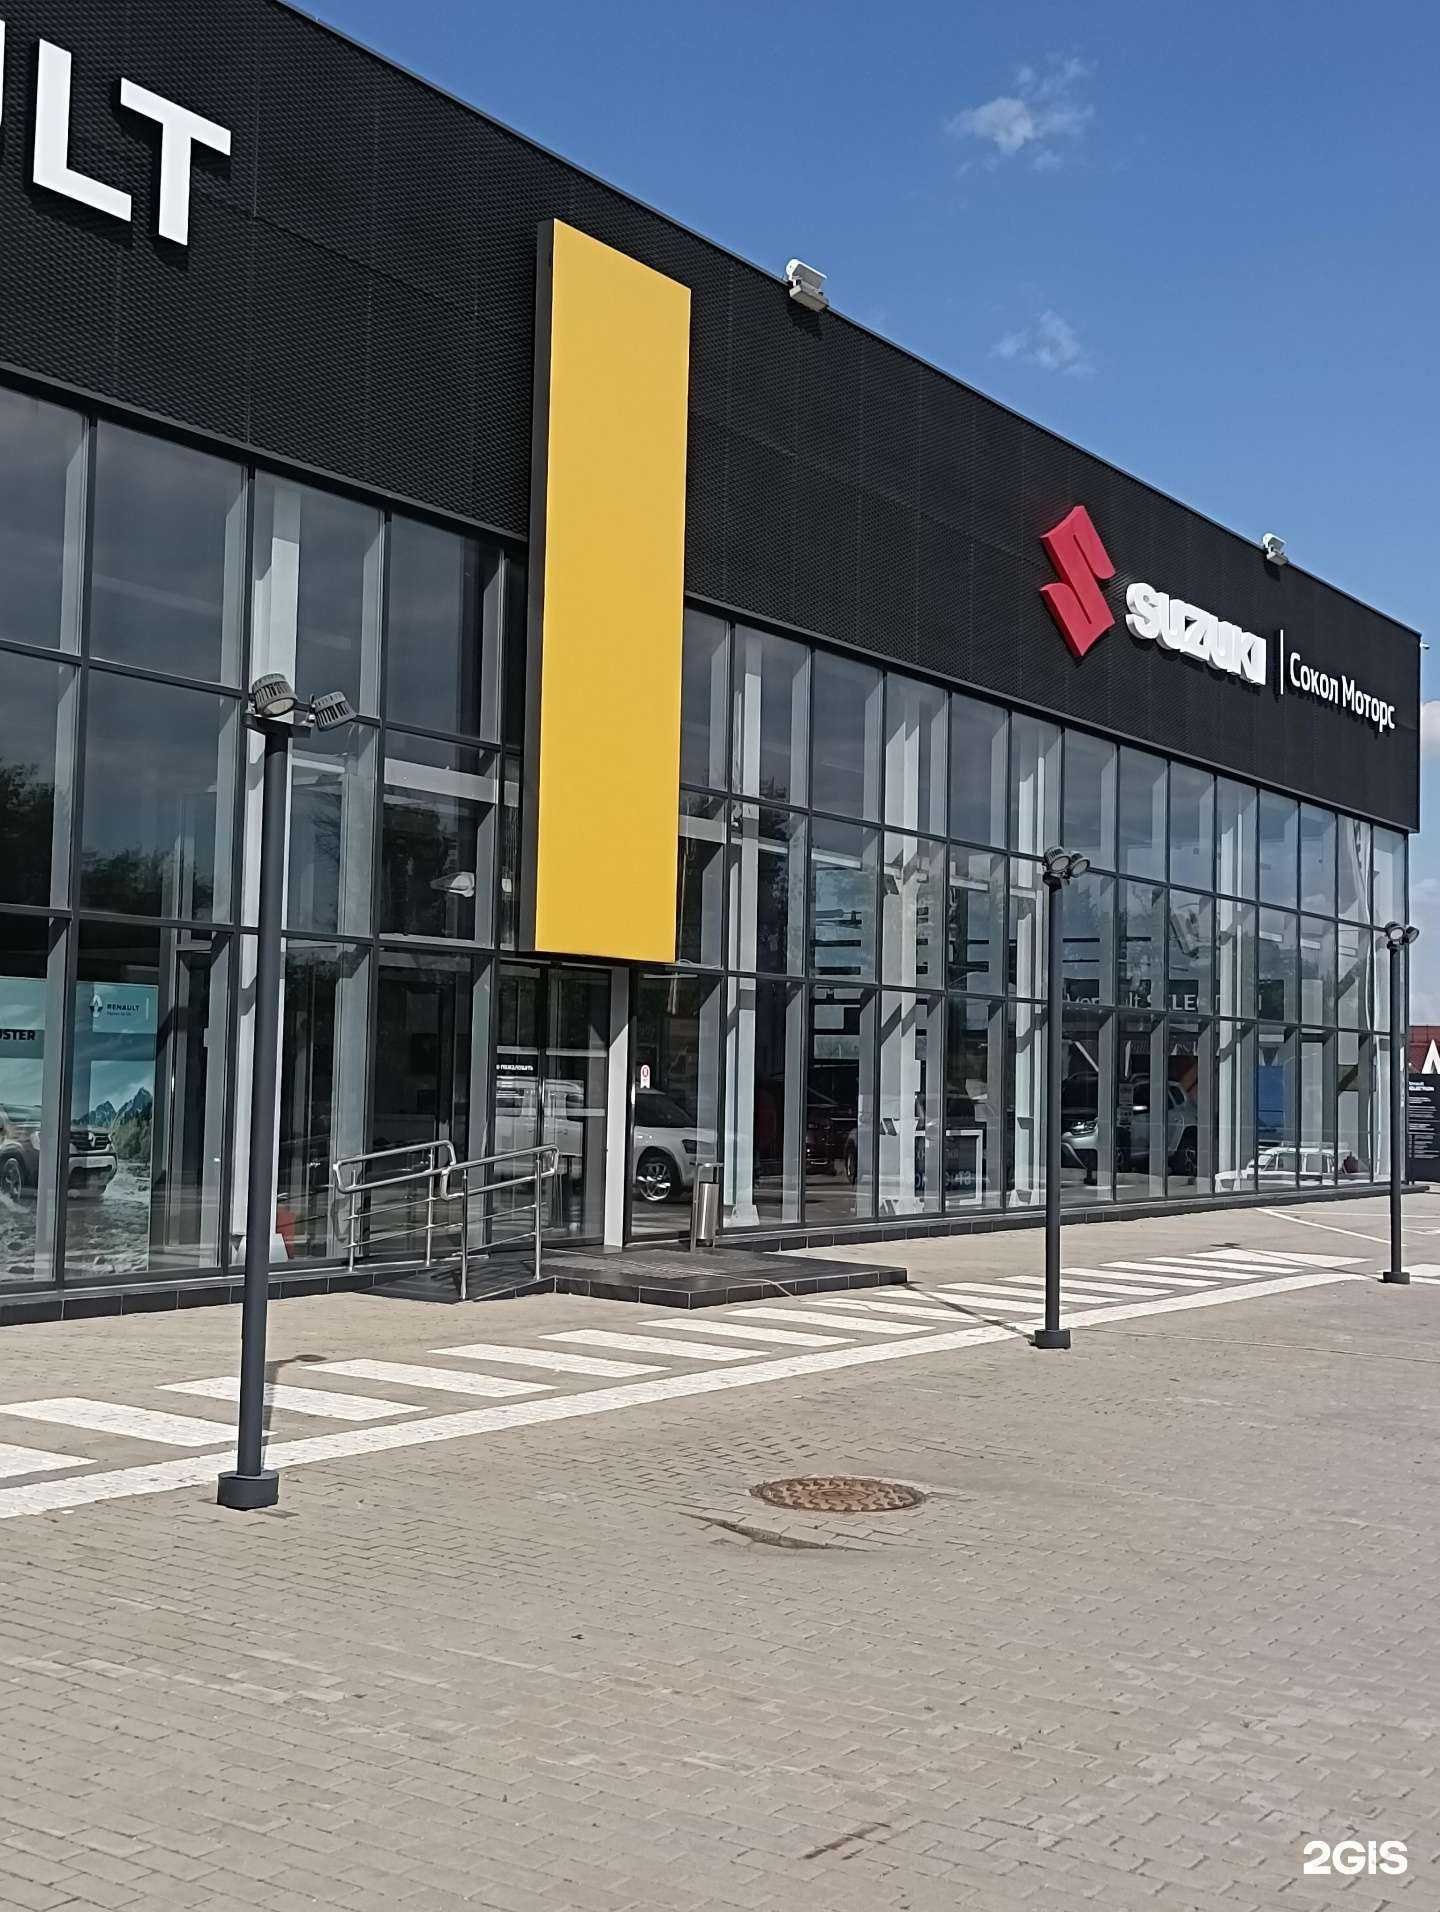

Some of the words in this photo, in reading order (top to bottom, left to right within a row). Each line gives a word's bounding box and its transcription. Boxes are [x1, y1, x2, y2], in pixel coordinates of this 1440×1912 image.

[0, 19, 231, 246] LT
[1126, 582, 1267, 686] SUZUKI
[1290, 652, 1339, 706] Сокол
[1342, 674, 1396, 732] Моторс
